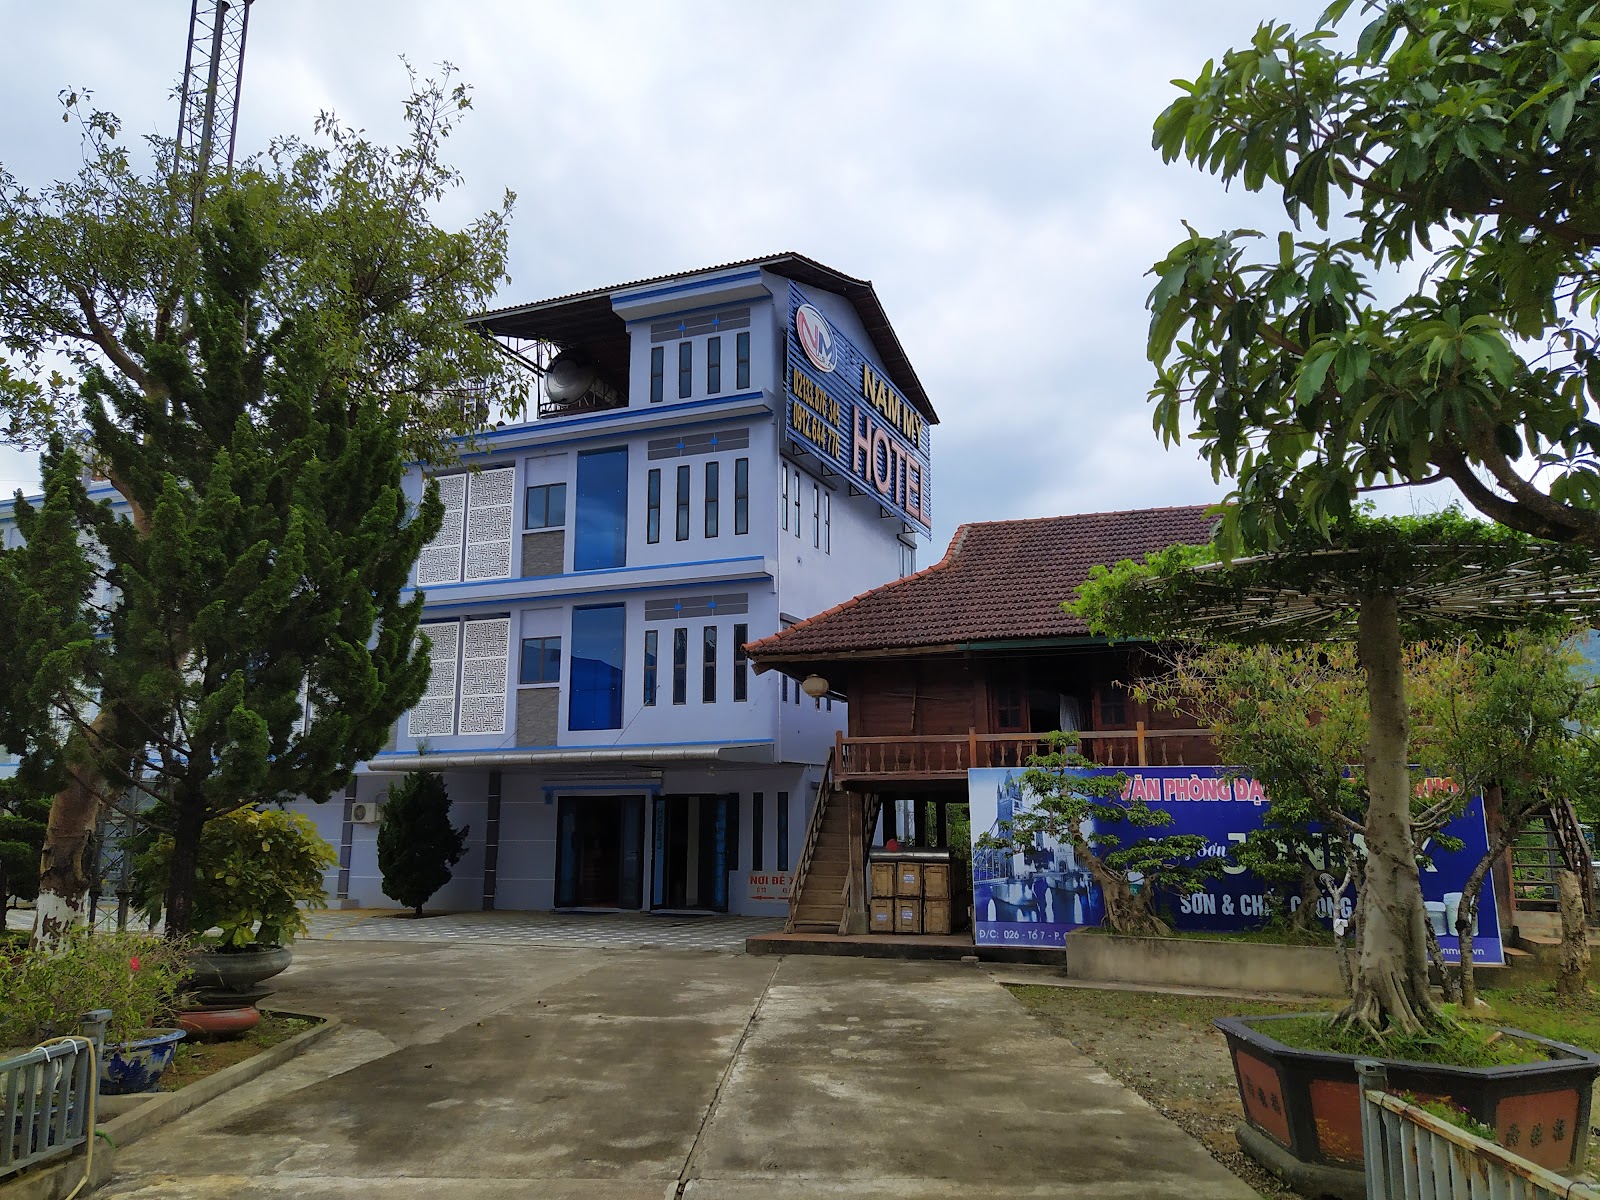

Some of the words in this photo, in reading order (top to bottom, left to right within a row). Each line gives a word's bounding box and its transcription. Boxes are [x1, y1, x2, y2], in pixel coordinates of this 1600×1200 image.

[864, 363, 900, 429] NAM
[828, 397, 840, 429] 345
[793, 401, 825, 450] 0912.644
[827, 428, 840, 459] 776
[853, 405, 931, 528] HOTEL
[1163, 774, 1232, 802] PHÒNG
[750, 875, 769, 885] NƠI
[1180, 892, 1217, 915] SƠN
[1221, 894, 1235, 916] &
[979, 929, 999, 939] Đ/C:
[1003, 929, 1020, 939] 026
[1027, 928, 1038, 940] Tổ
[1054, 931, 1061, 941] P.
